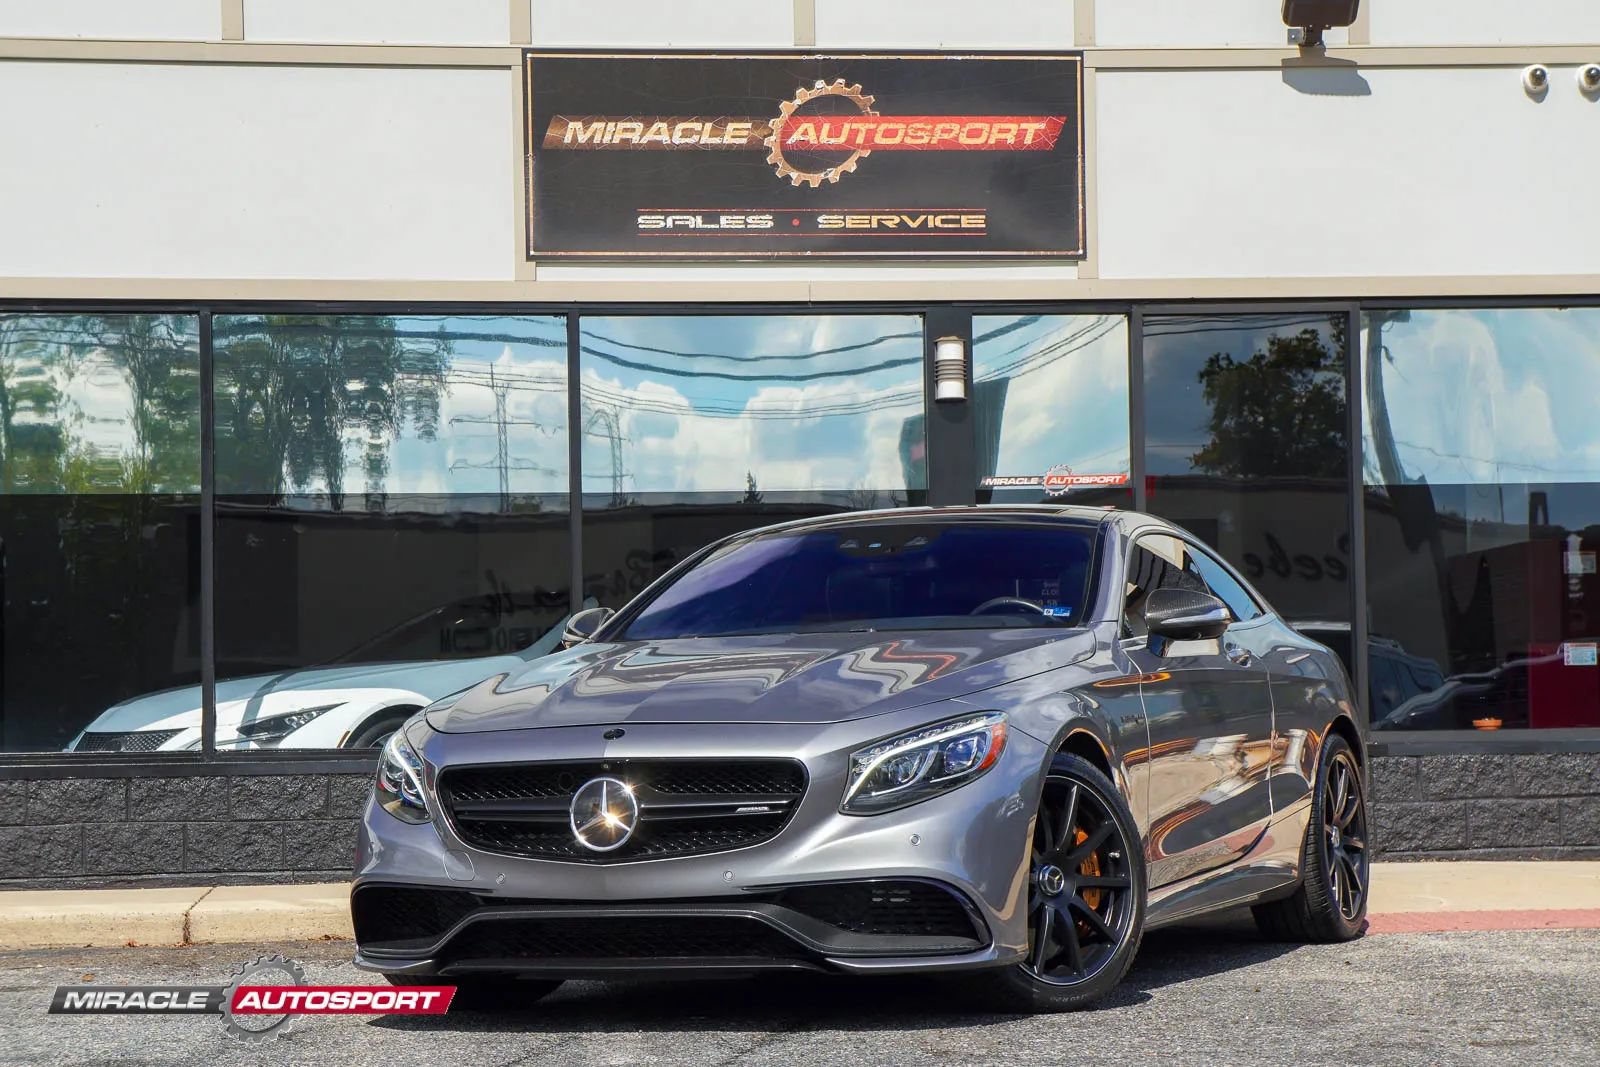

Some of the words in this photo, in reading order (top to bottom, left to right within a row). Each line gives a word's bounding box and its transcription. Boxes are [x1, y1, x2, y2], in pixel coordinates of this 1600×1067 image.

[563, 121, 752, 145] MIRACLE
[786, 121, 1044, 145] AUTOSPORT
[637, 214, 774, 229] SALES
[817, 214, 986, 229] SERVICE
[985, 477, 1039, 486] MIRACLE
[1048, 475, 1123, 485] AUTOSPORT
